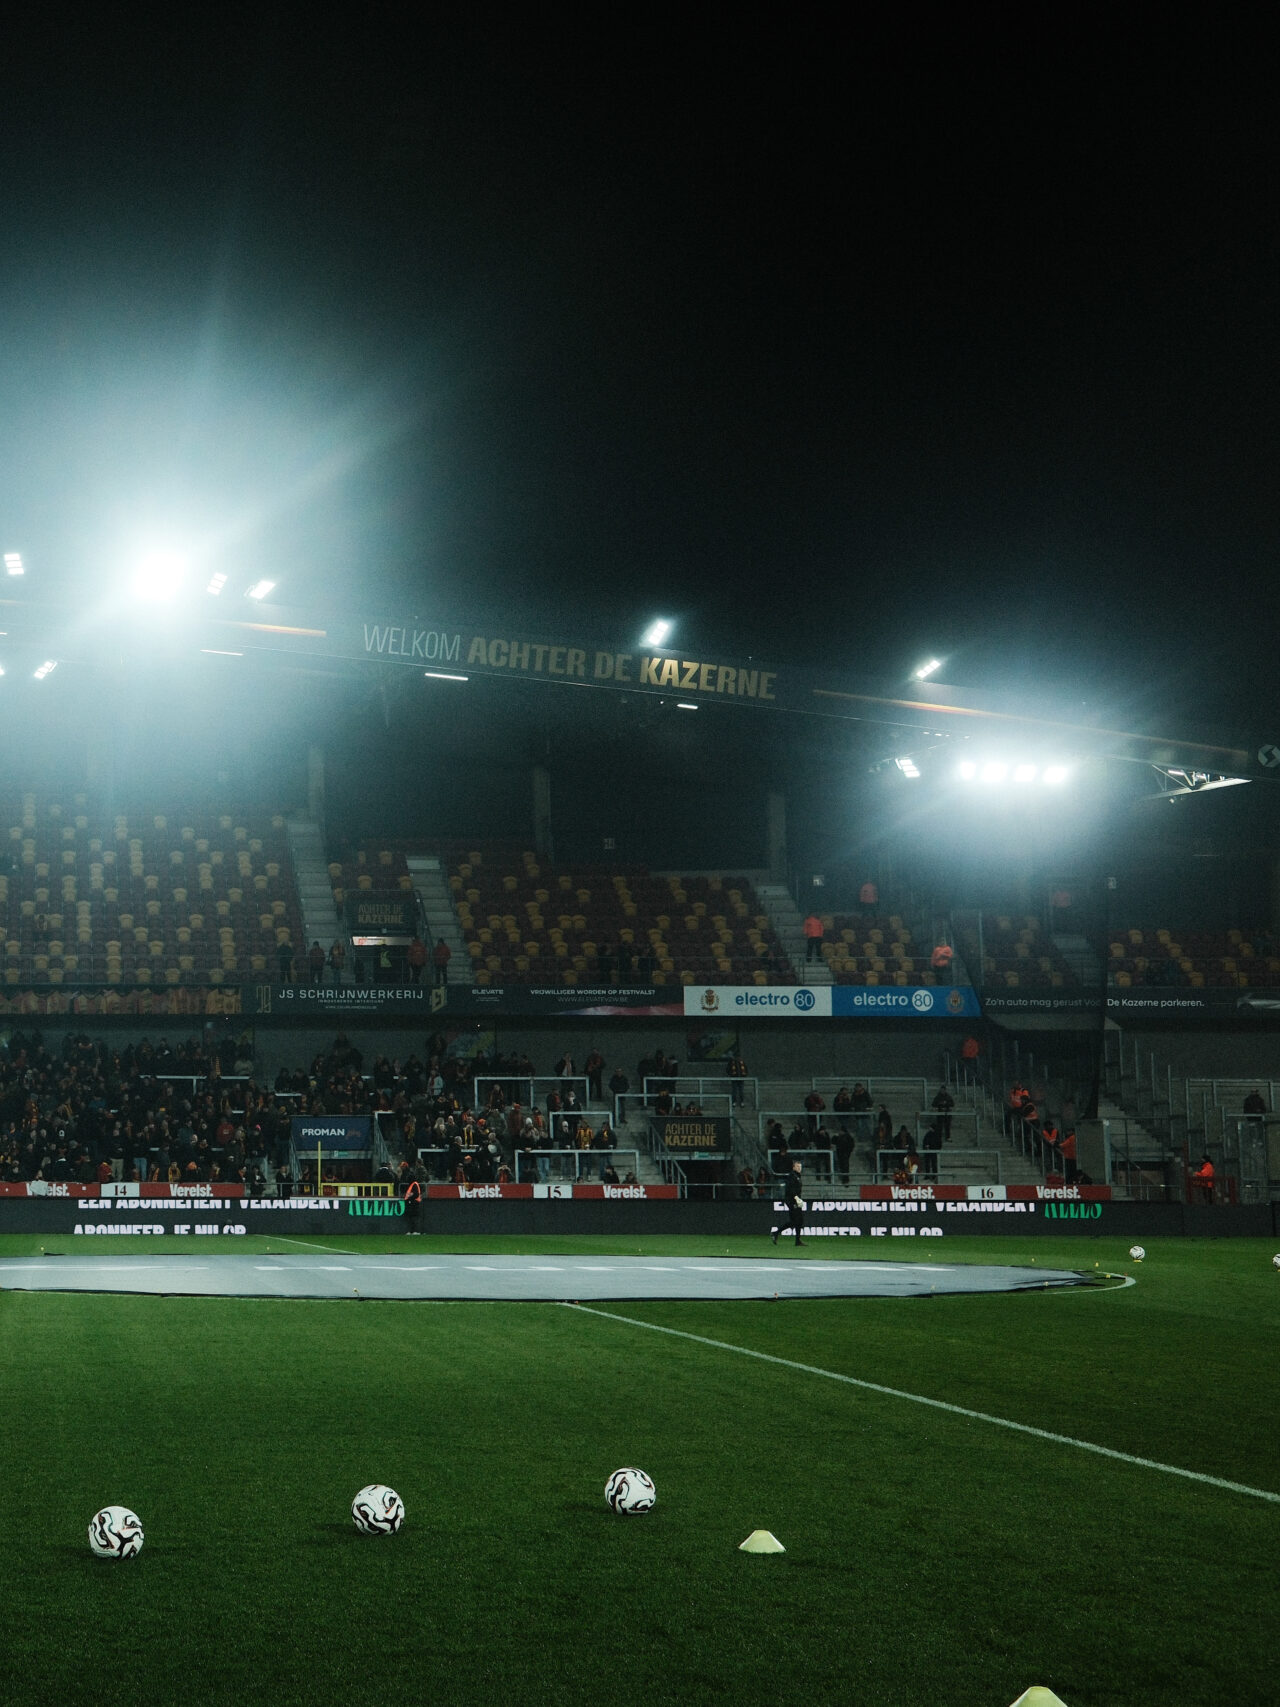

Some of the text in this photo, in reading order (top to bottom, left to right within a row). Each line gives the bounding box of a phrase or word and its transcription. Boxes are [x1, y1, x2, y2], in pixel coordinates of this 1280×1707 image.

[362, 623, 778, 700] WELKOM ACHTER DE KAZERNE
[278, 989, 424, 999] JS SCHRIJNWERKERIJ
[735, 991, 815, 1007] electro 80
[853, 992, 933, 1007] electro 80
[1006, 999, 1029, 1007] auto
[1030, 1000, 1051, 1008] mag
[1052, 999, 1082, 1008] gerust
[1106, 998, 1205, 1009] De Kazerne parkeren.
[665, 1124, 716, 1135] ACHTER DE
[664, 1135, 717, 1146] KAZERNE
[25, 1183, 70, 1197] Velst.
[113, 1184, 127, 1196] 14
[169, 1184, 213, 1197] Verelst.
[458, 1184, 503, 1198] Verelst.
[549, 1185, 562, 1199] 15
[602, 1185, 648, 1199] Verelst.
[890, 1185, 936, 1199] Verelst.
[981, 1187, 995, 1199] 16
[1035, 1186, 1081, 1199] Verelst.
